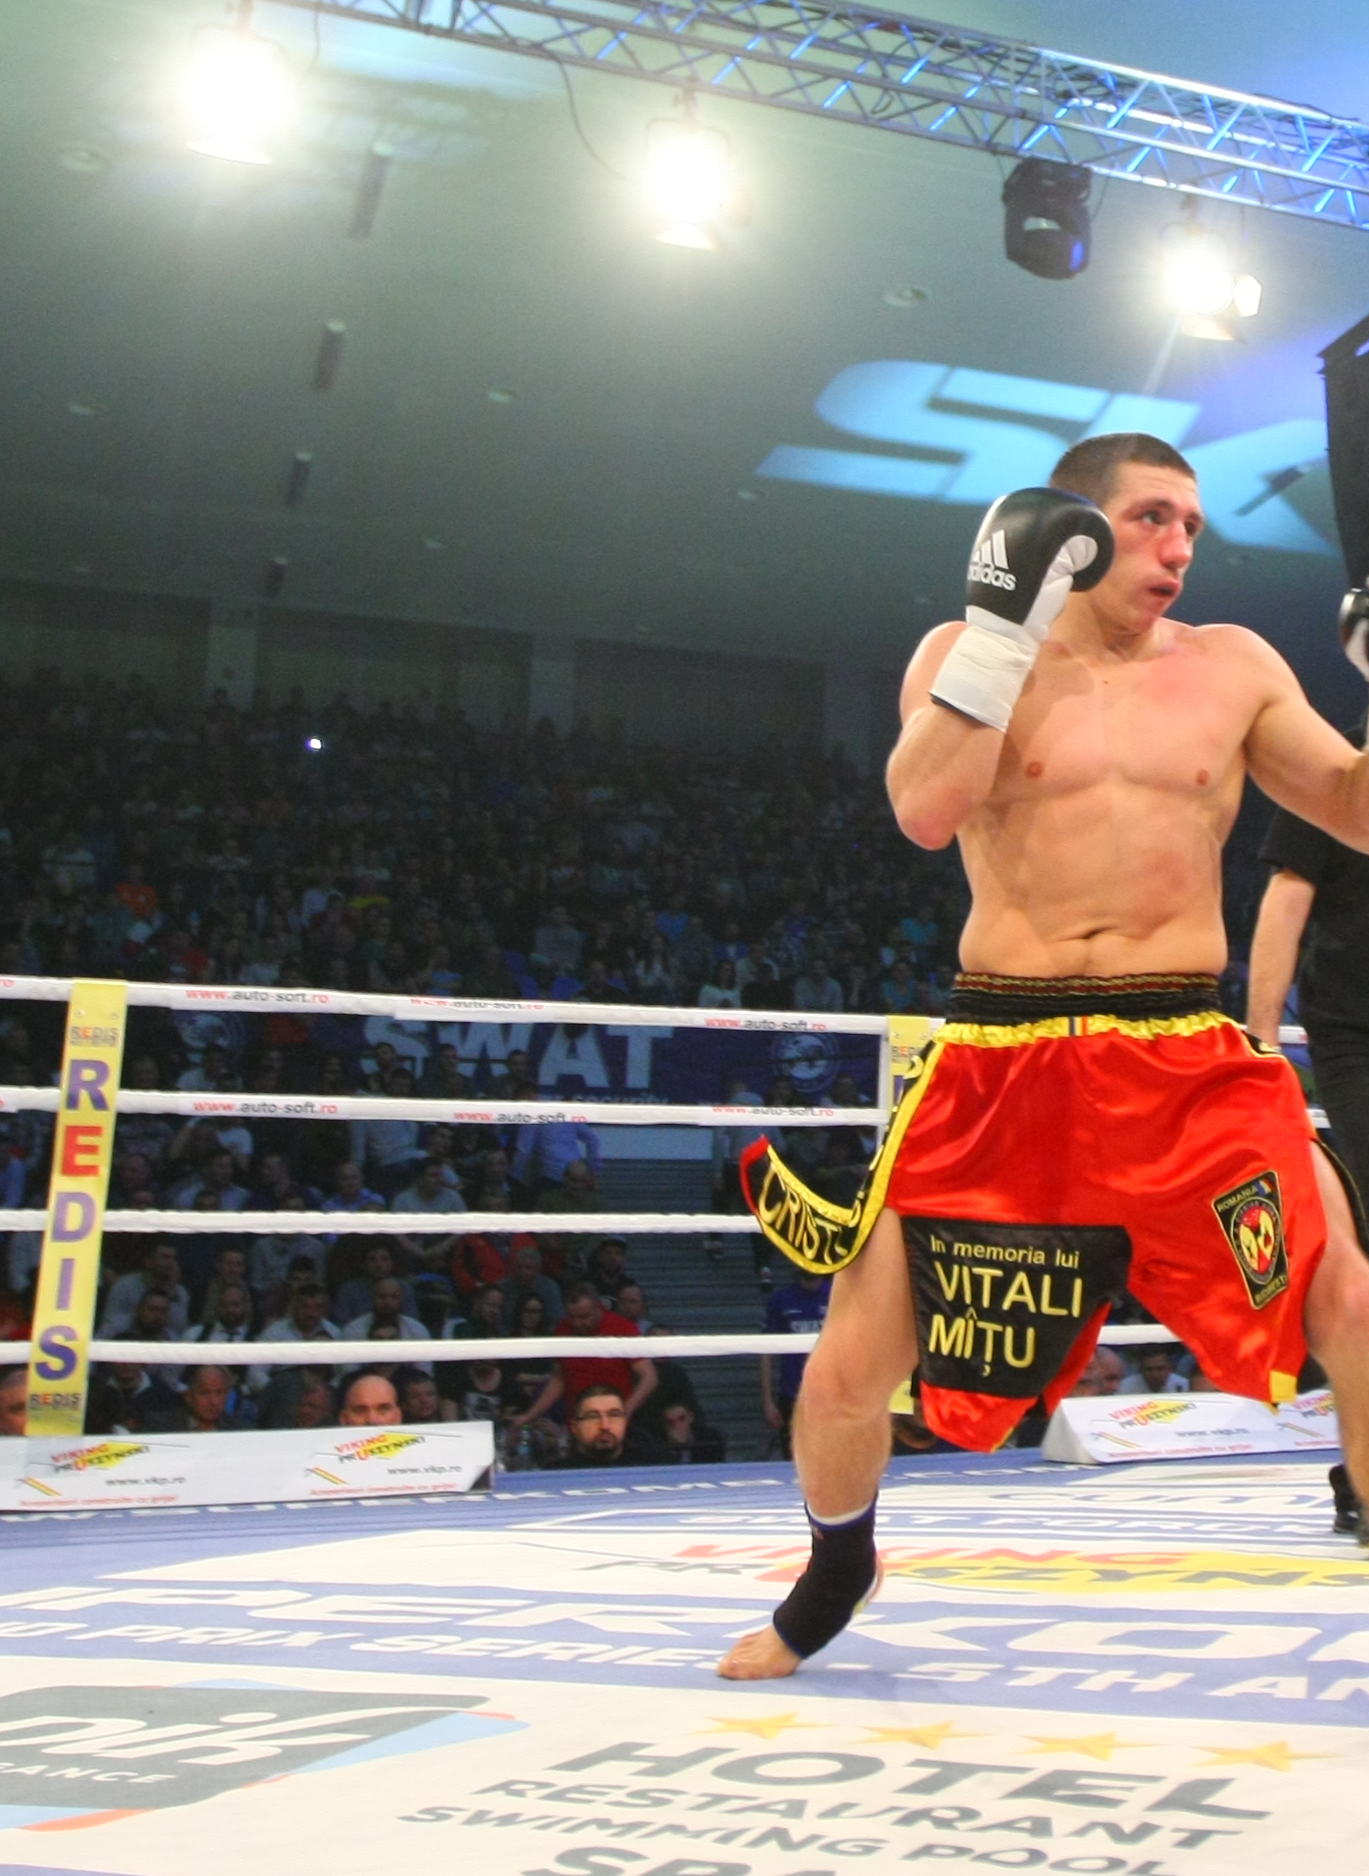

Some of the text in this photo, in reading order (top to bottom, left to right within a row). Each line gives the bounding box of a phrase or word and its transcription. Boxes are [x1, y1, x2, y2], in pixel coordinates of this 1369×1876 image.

[186, 988, 329, 1004] www.auto-soft.ro
[193, 1100, 338, 1115] www.auto-soft.ro
[954, 1241, 1046, 1266] memoria
[1055, 1248, 1080, 1269] lui
[935, 1260, 1082, 1318] VITALI
[671, 1544, 1204, 1566] VIING
[66, 1624, 366, 1648] PRIX
[891, 1662, 1196, 1692] 5TH
[544, 1741, 1272, 1820] HOTEL
[396, 1806, 892, 1858] SWIMMING
[471, 1779, 1244, 1849] RESTAURANT
